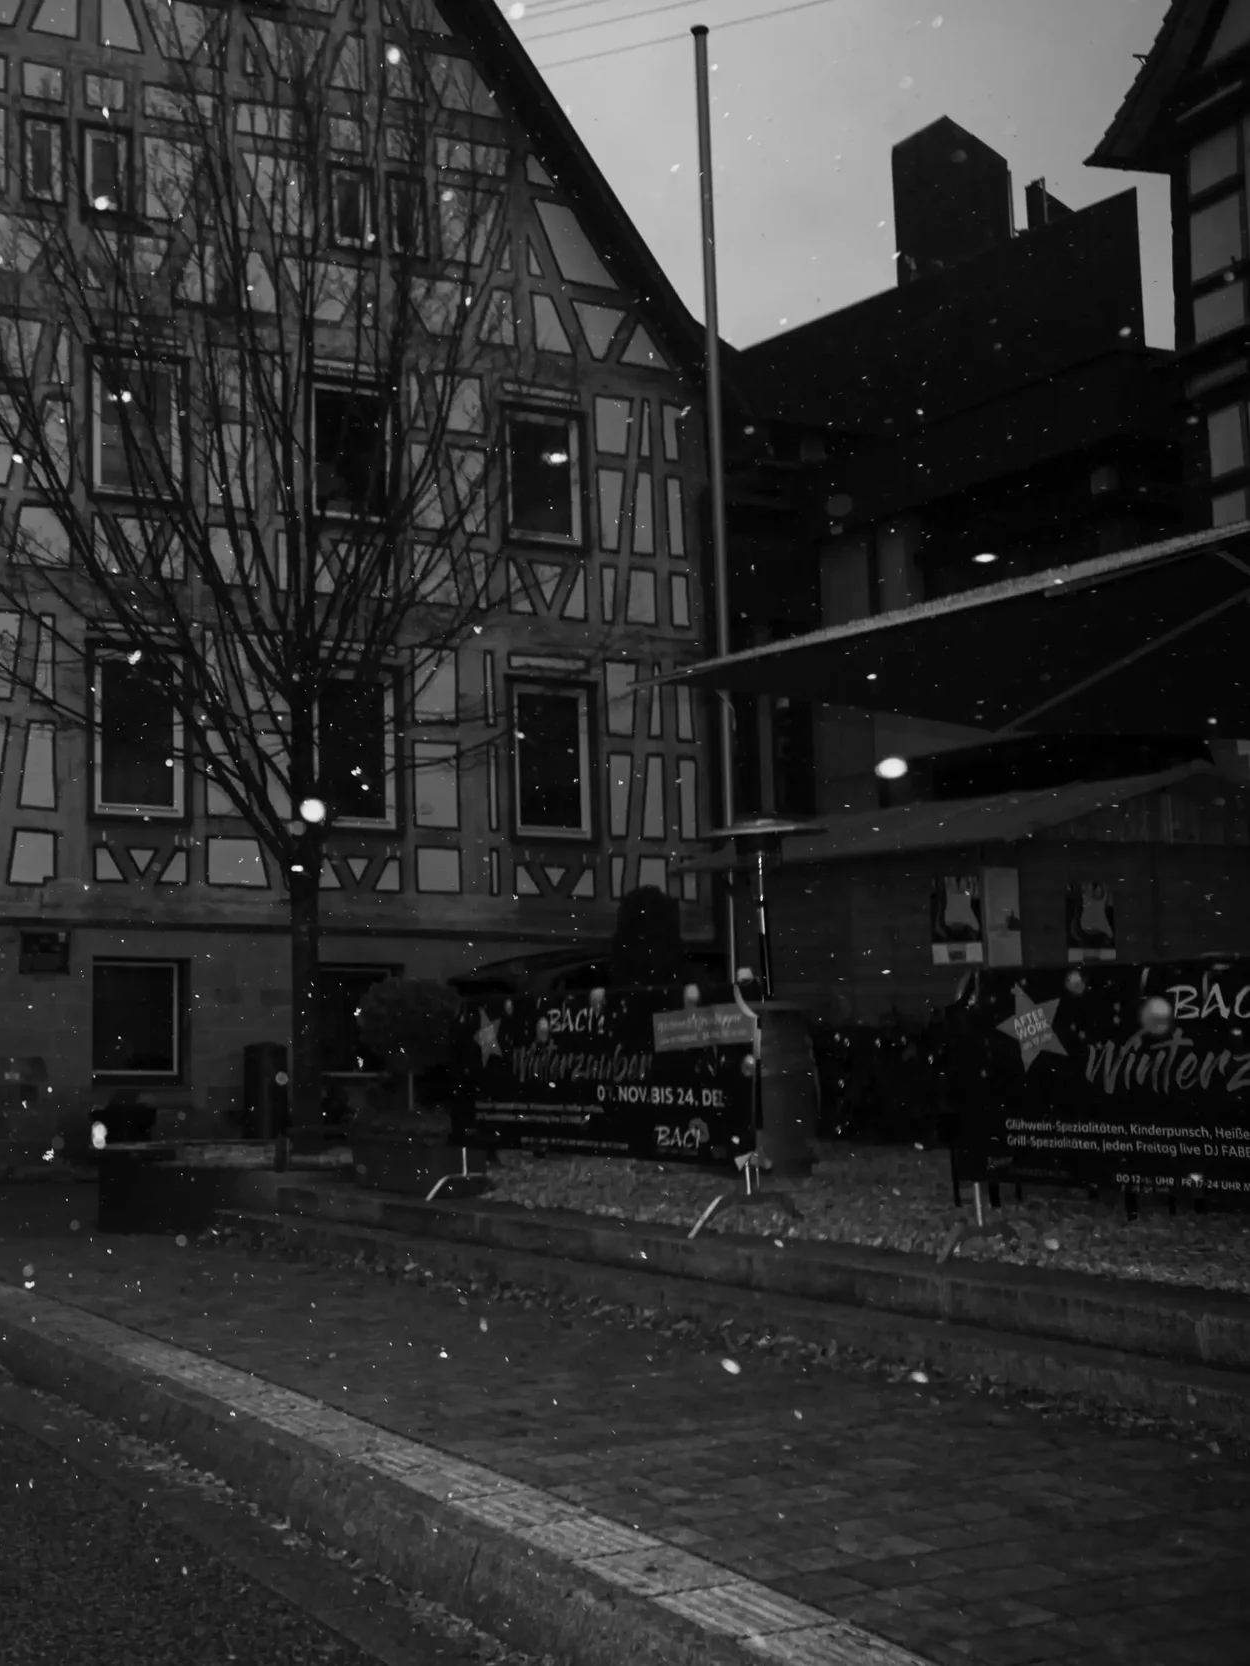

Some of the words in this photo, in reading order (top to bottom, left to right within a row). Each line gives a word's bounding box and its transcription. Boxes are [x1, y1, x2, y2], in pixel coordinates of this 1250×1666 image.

[1014, 1007, 1045, 1029] AFTER
[1015, 1018, 1050, 1040] WORK
[513, 1039, 653, 1083] Winterzauber
[651, 1086, 674, 1104] BIS
[676, 1087, 699, 1107] 24.
[1005, 1117, 1128, 1136] Glühwein-Spezialitäten,
[1130, 1123, 1213, 1140] Kinderpunsch,
[1006, 1134, 1100, 1152] Grill-Spezialitäten,
[1102, 1138, 1134, 1153] jeden
[1136, 1141, 1178, 1157] Freitag
[1180, 1142, 1201, 1155] live
[1204, 1144, 1219, 1156] DJ
[1116, 1173, 1130, 1184] DO
[1155, 1175, 1175, 1187] UHR
[1181, 1177, 1192, 1187] FR
[1221, 1181, 1242, 1191] UHR
